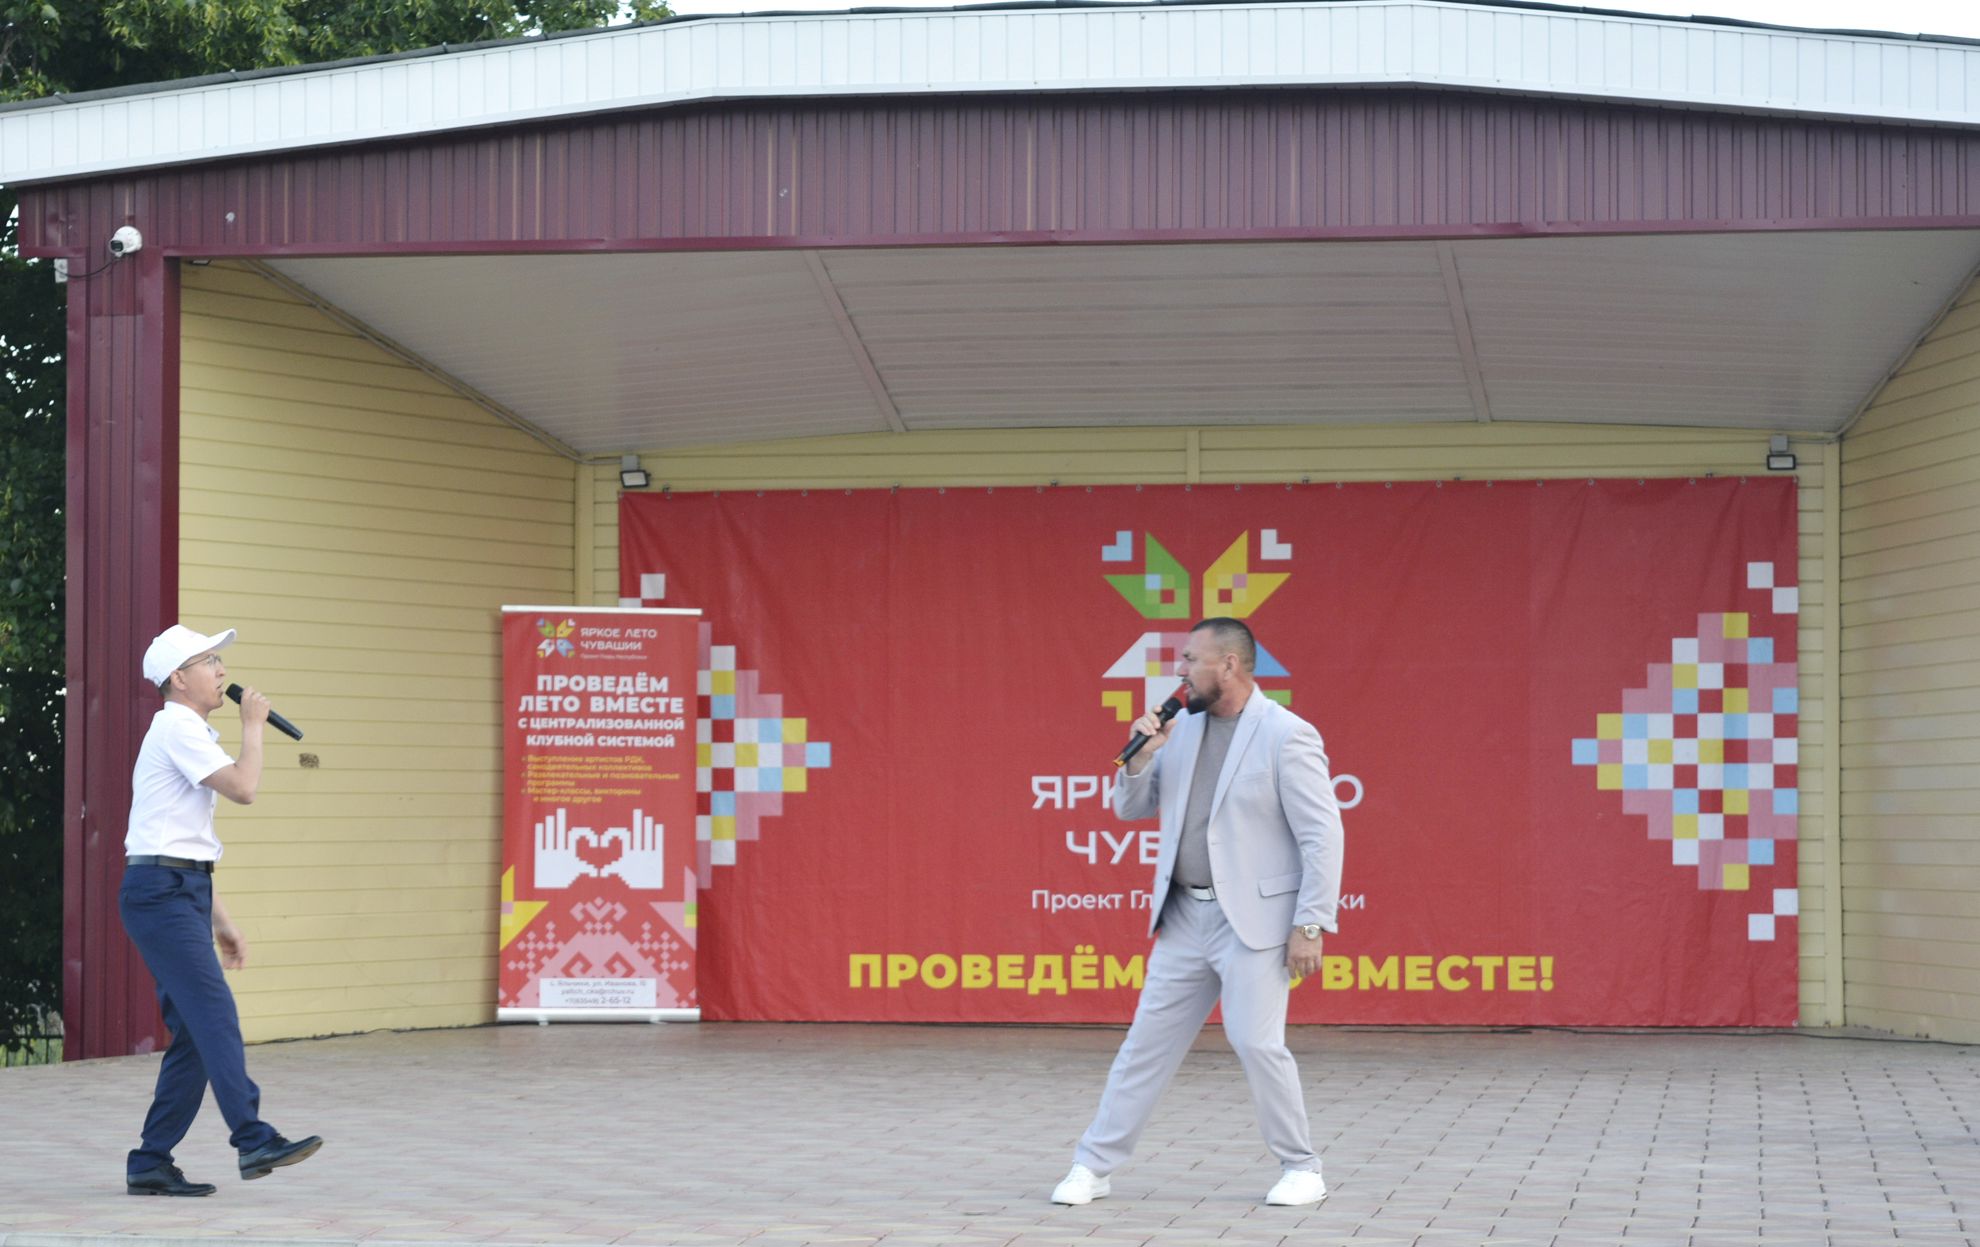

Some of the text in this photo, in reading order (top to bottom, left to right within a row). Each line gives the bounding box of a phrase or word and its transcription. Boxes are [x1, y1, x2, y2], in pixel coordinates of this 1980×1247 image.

[580, 627, 658, 639] ЯРКОЕ ЛЕТО
[580, 640, 643, 651] ЧУВАШИИ
[536, 672, 669, 695] ПРОВЕДЁМ
[518, 695, 685, 714] ЛЕТО ВМЕСТЕ
[518, 717, 685, 731] С ЦЕНТРАЛИЗОВАННОЙ
[526, 733, 676, 748] КЛУБНОЙ СИСТЕМОЙ
[1032, 889, 1124, 915] Проект
[848, 944, 1145, 996] ПРОВЕДЁМ
[1321, 954, 1555, 992] ВМЕСТЕ!
